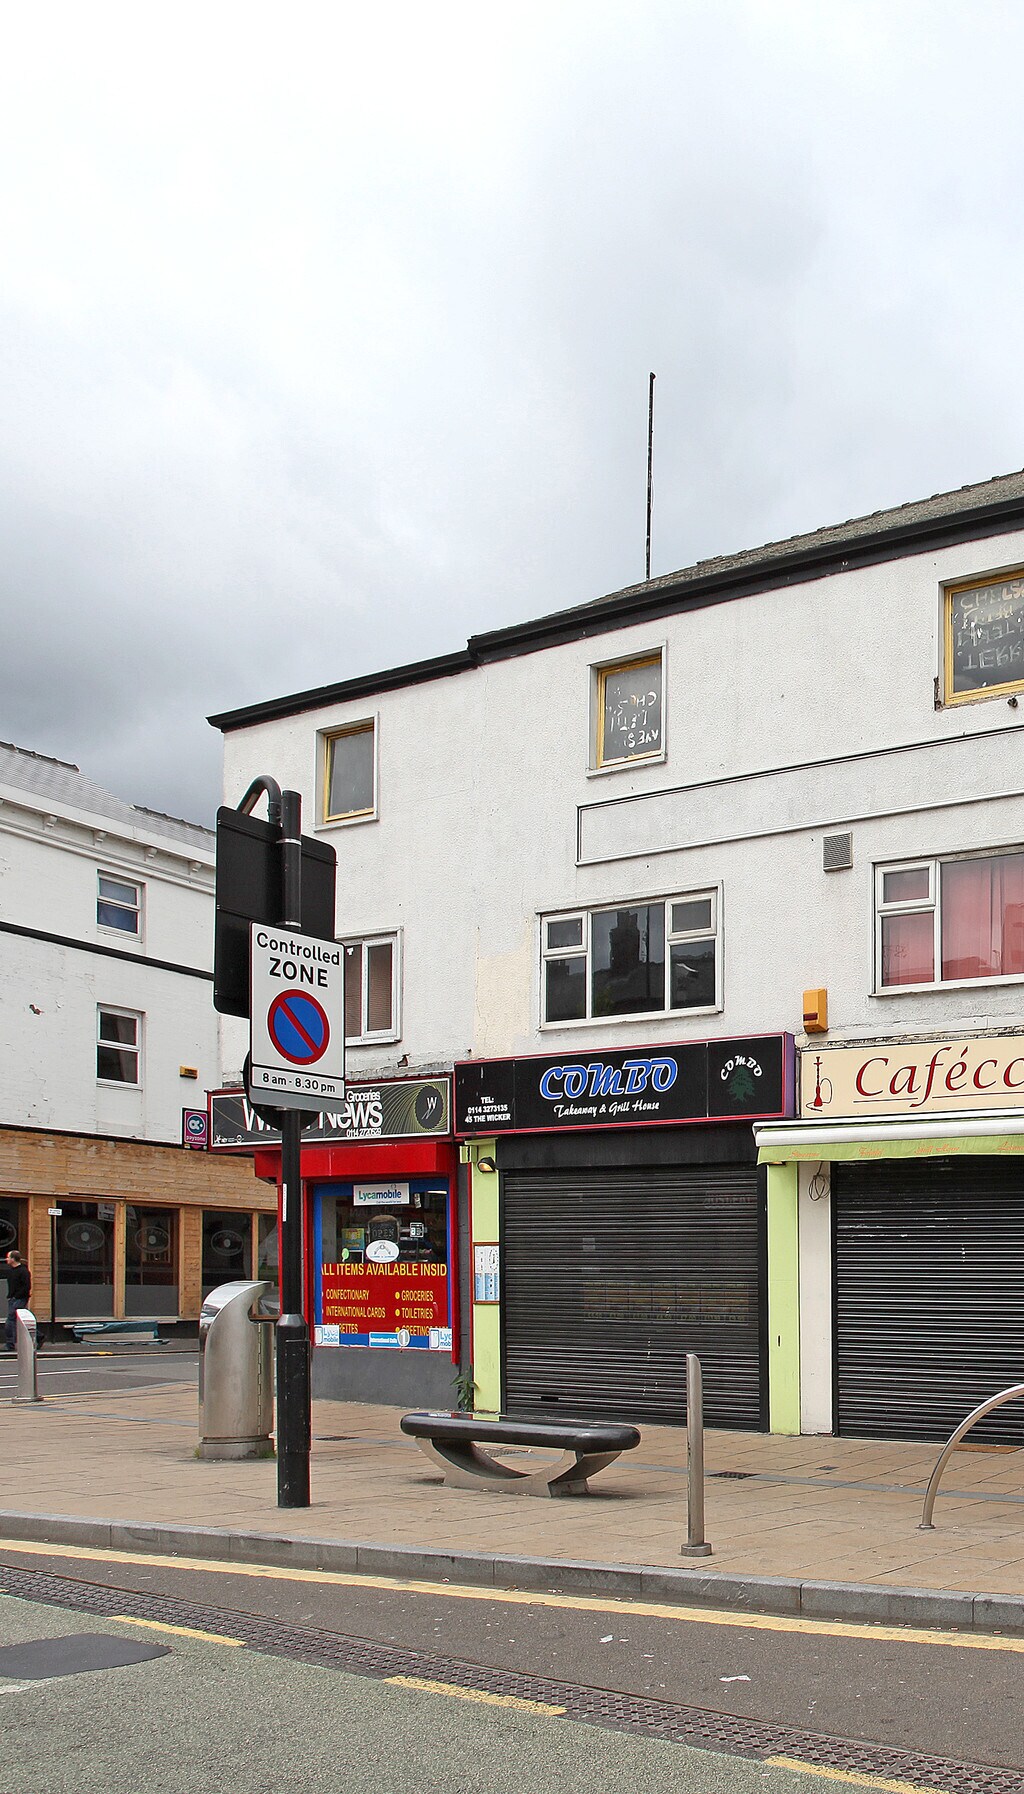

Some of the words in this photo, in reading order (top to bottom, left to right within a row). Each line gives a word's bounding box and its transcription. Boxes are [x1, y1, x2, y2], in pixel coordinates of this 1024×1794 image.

[256, 932, 340, 966] Controlled
[269, 956, 328, 988] ZONE
[262, 1073, 269, 1083] 8
[271, 1076, 287, 1086] am
[295, 1077, 319, 1090] 8.30
[321, 1083, 336, 1093] pm
[346, 1089, 380, 1102] Groceries
[480, 1096, 495, 1104] TEL:
[467, 1106, 482, 1114] 0114
[553, 1104, 598, 1119] Takeaway
[598, 1104, 607, 1114] &
[609, 1101, 631, 1117] Grill
[631, 1098, 660, 1112] House
[473, 1115, 486, 1123] THE
[486, 1113, 511, 1122] WICKER
[358, 1189, 402, 1202] Lycamobile
[336, 1263, 365, 1276] ITEMS
[366, 1263, 419, 1276] AVAILABLE
[326, 1288, 370, 1300] CONFECTIONARY
[401, 1290, 434, 1302] GROCERIES
[326, 1305, 367, 1317] INTERNATIONAL
[366, 1306, 386, 1318] CARDS
[401, 1307, 434, 1319] TOILETRIES
